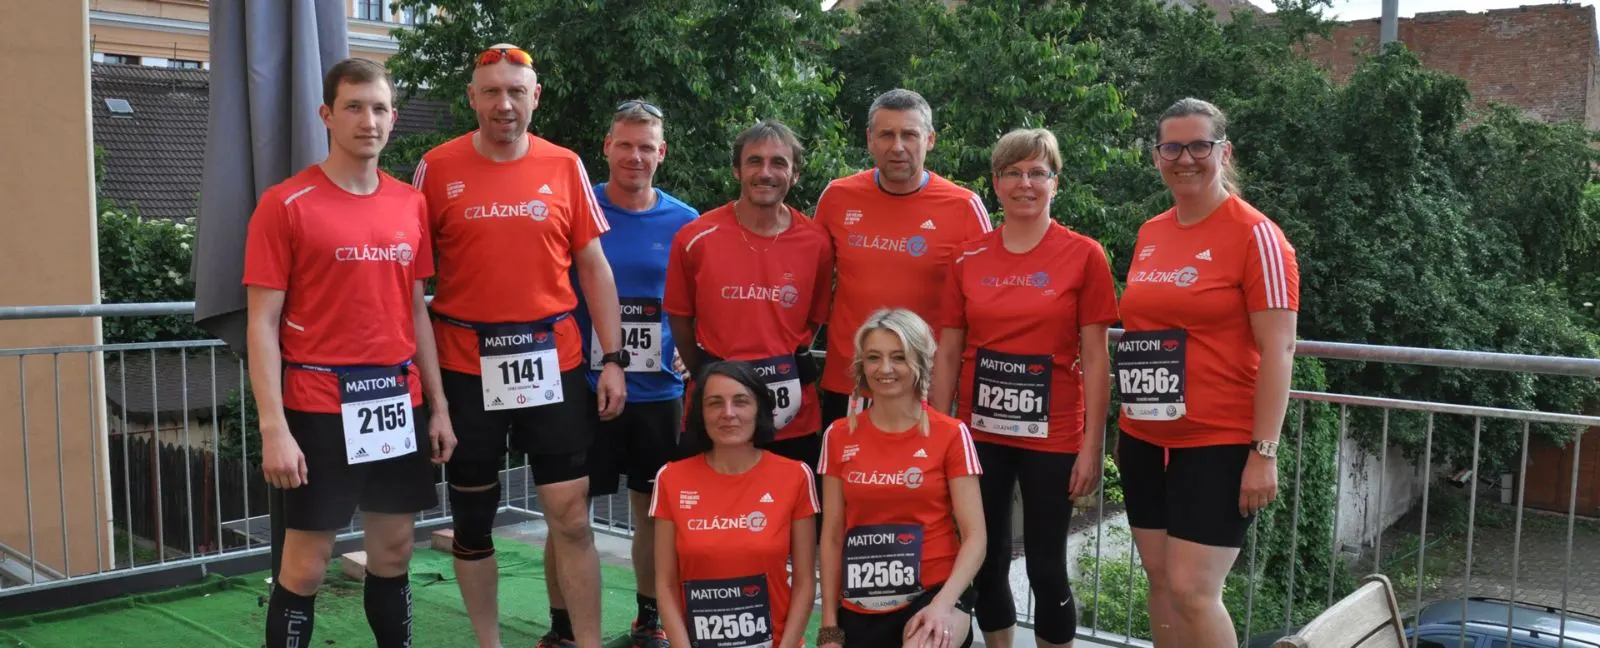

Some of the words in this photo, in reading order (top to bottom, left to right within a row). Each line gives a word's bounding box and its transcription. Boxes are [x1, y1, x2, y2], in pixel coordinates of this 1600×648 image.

[619, 304, 642, 315] TONI
[485, 333, 533, 348] MATTONI
[1117, 339, 1161, 353] MATTONI
[498, 356, 544, 385] 1141
[980, 357, 1026, 374] MATTONI
[346, 375, 397, 393] MATTONI
[1118, 367, 1180, 394] R2562
[978, 383, 1043, 413] R2561
[357, 401, 407, 435] 2155
[847, 533, 895, 548] MATTONI
[847, 560, 915, 589] R2563
[691, 586, 741, 600] MATTONI
[694, 612, 768, 640] R2564
